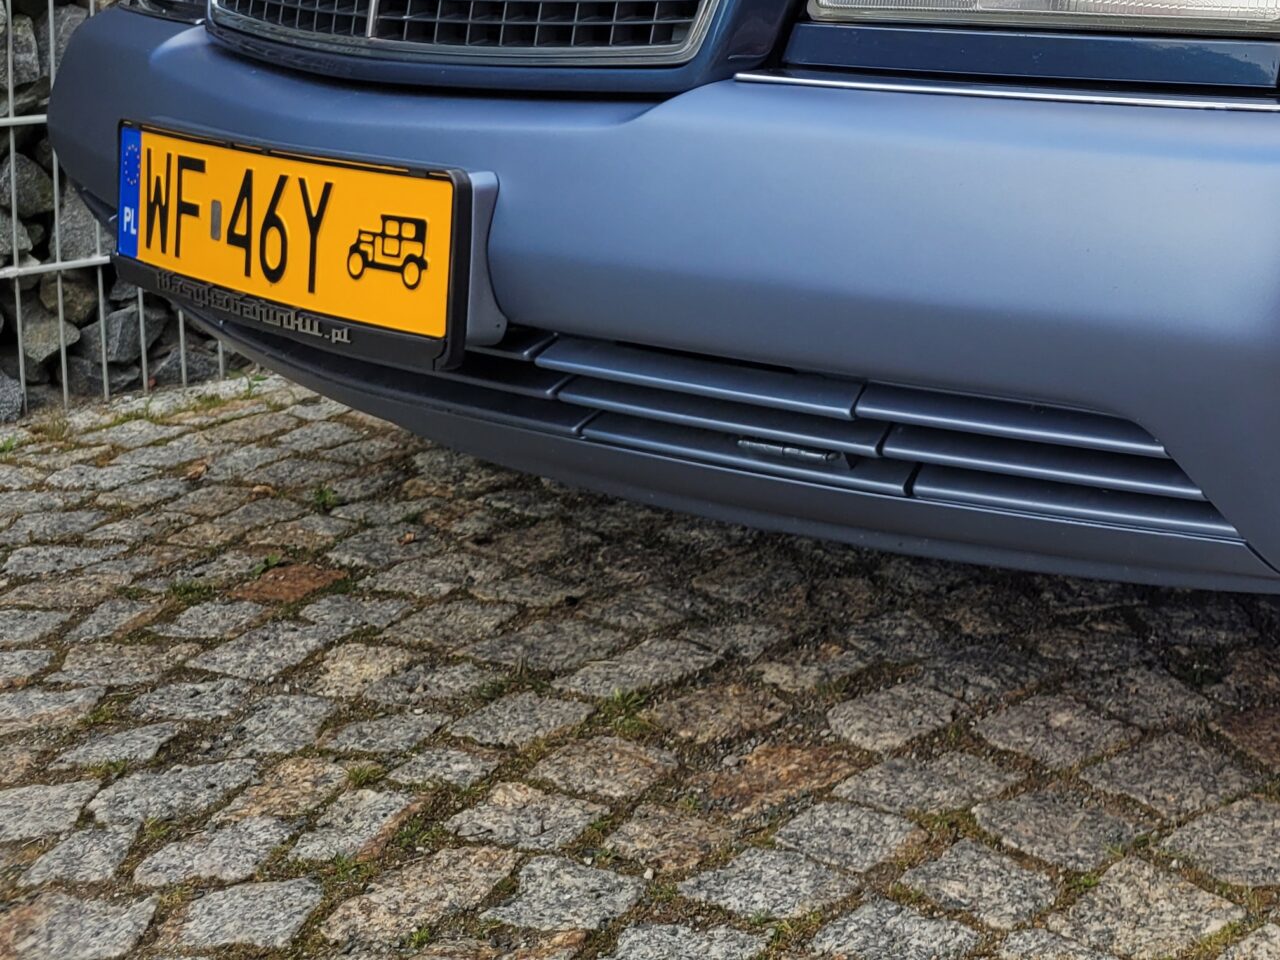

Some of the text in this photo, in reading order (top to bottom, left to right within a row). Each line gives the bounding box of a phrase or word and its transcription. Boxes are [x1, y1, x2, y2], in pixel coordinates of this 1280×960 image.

[123, 206, 137, 235] PL
[146, 148, 334, 294] WF 46Y
